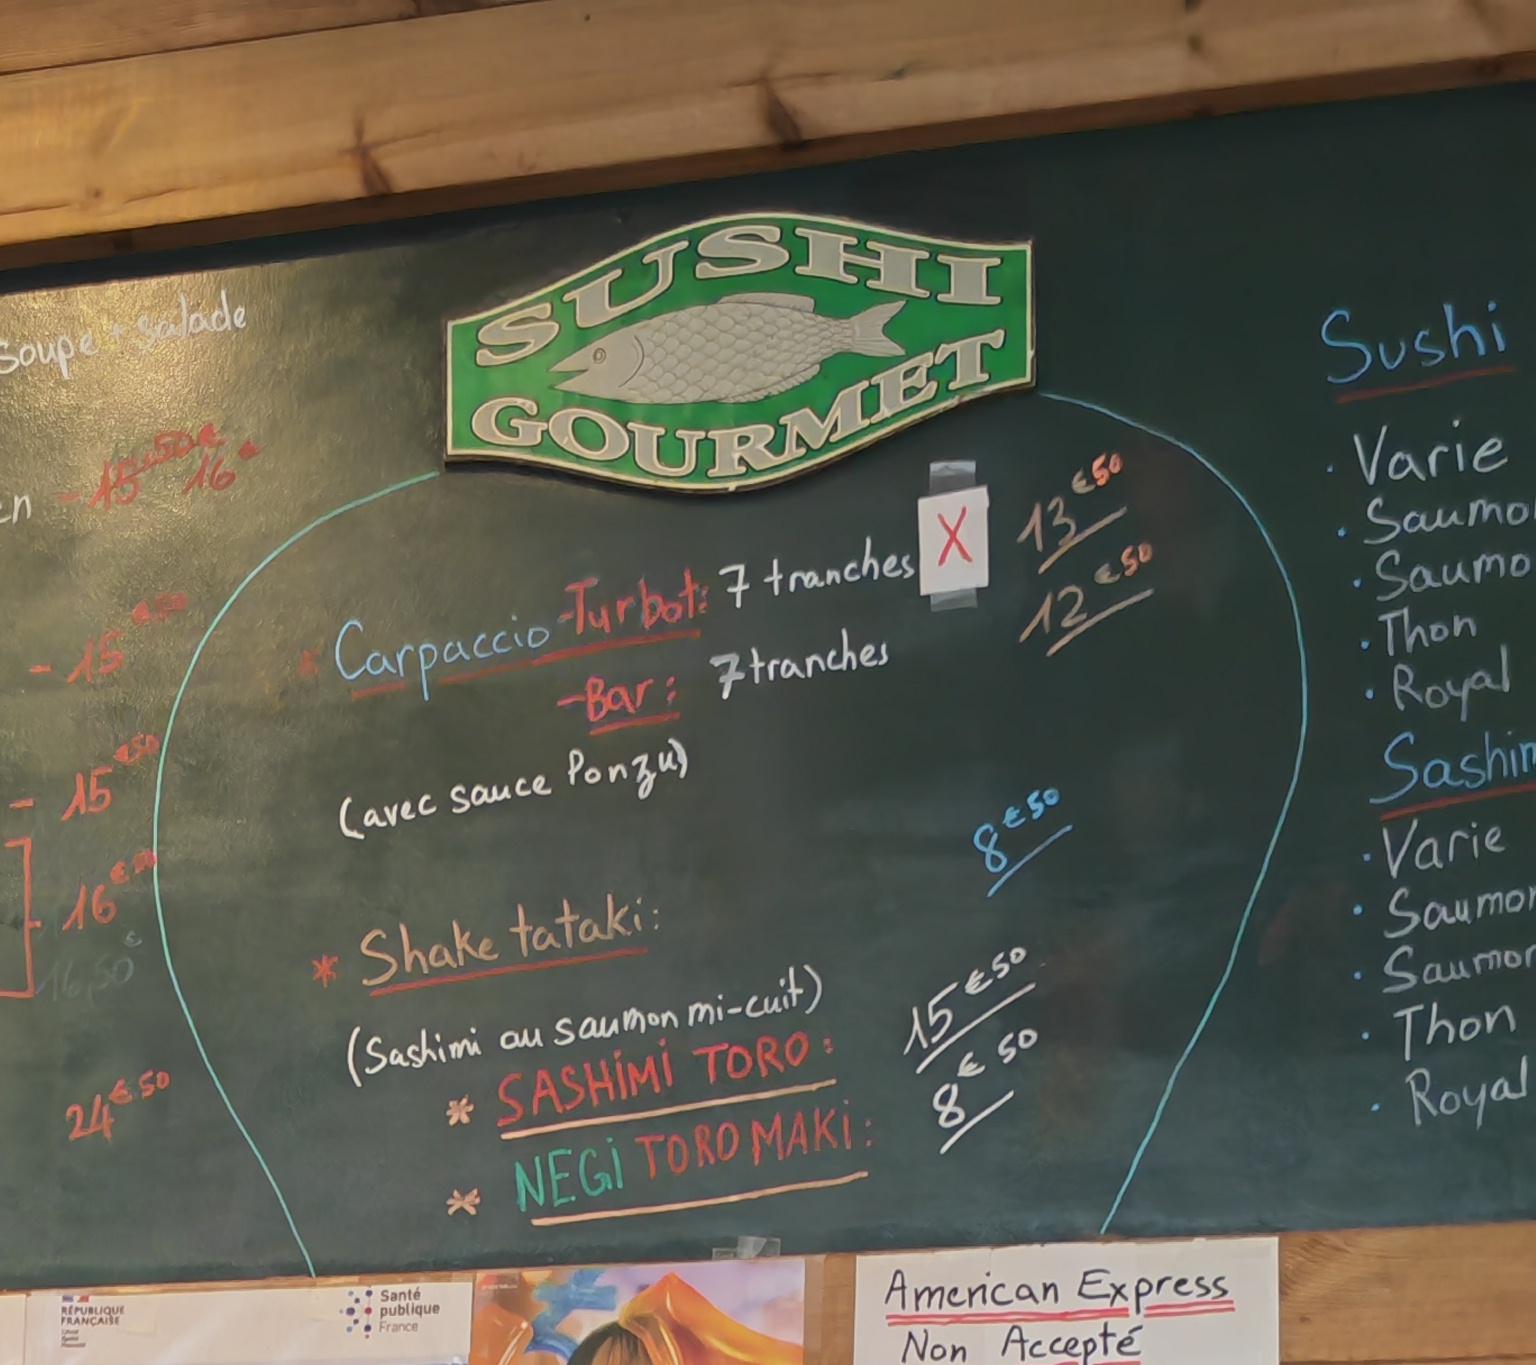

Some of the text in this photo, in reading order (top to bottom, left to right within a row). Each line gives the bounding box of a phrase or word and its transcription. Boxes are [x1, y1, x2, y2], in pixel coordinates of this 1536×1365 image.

[475, 224, 1003, 367] SUSHI
[1321, 301, 1507, 384] Sushi
[471, 329, 1007, 478] GOURMET
[334, 614, 550, 701] Carpaccio
[718, 563, 751, 609] 7
[764, 535, 915, 597] tranches
[709, 653, 746, 700] 7
[749, 628, 889, 685] tranches
[1393, 644, 1510, 722] Royal
[339, 793, 437, 839] (avec
[450, 774, 553, 816] sauce
[360, 920, 499, 988] Shake
[347, 1025, 482, 1088] (Sashimi
[500, 1028, 543, 1051] au
[635, 1120, 739, 1177] TORO
[61, 1305, 125, 1316] RÉPUBLIQUE
[61, 1316, 120, 1328] FRANÇAISE
[380, 1288, 421, 1302] Santé
[380, 1302, 441, 1319] publique
[884, 1268, 1230, 1316] American Express
[379, 1320, 419, 1333] France
[901, 1330, 967, 1365] Non
